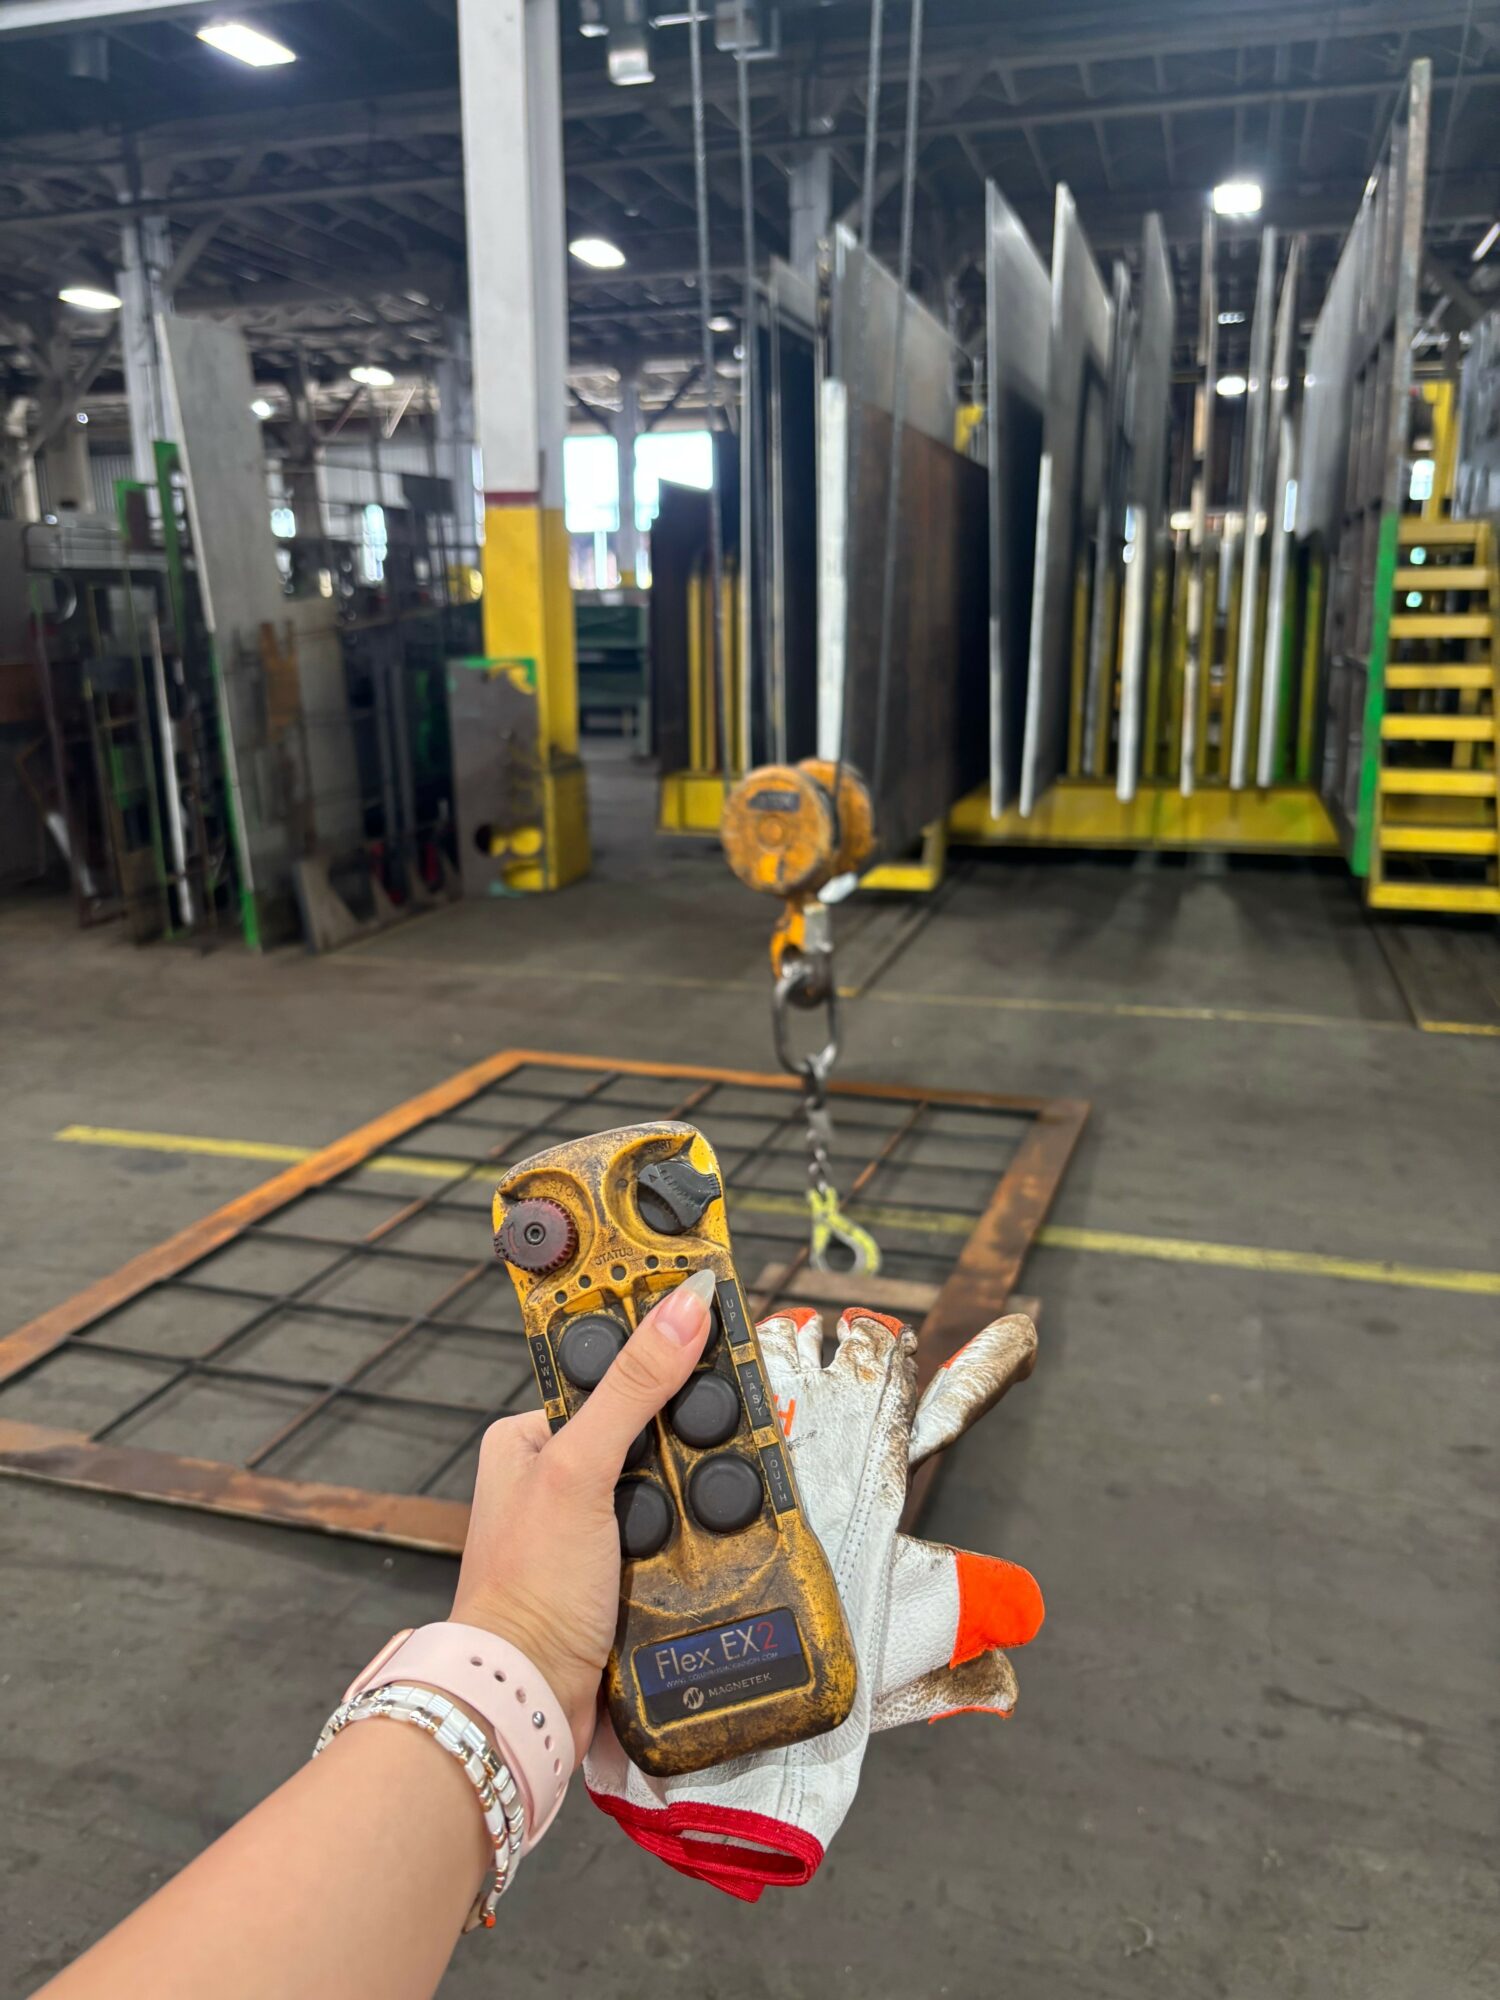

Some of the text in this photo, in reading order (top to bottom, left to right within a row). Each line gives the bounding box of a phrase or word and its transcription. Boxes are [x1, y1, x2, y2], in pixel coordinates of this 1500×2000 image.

[595, 1247, 634, 1265] STATUS
[726, 1299, 737, 1321] UP
[535, 1342, 552, 1389] DOWN
[655, 1621, 778, 1680] Flex EX2
[708, 1672, 773, 1698] MAGNETEK
